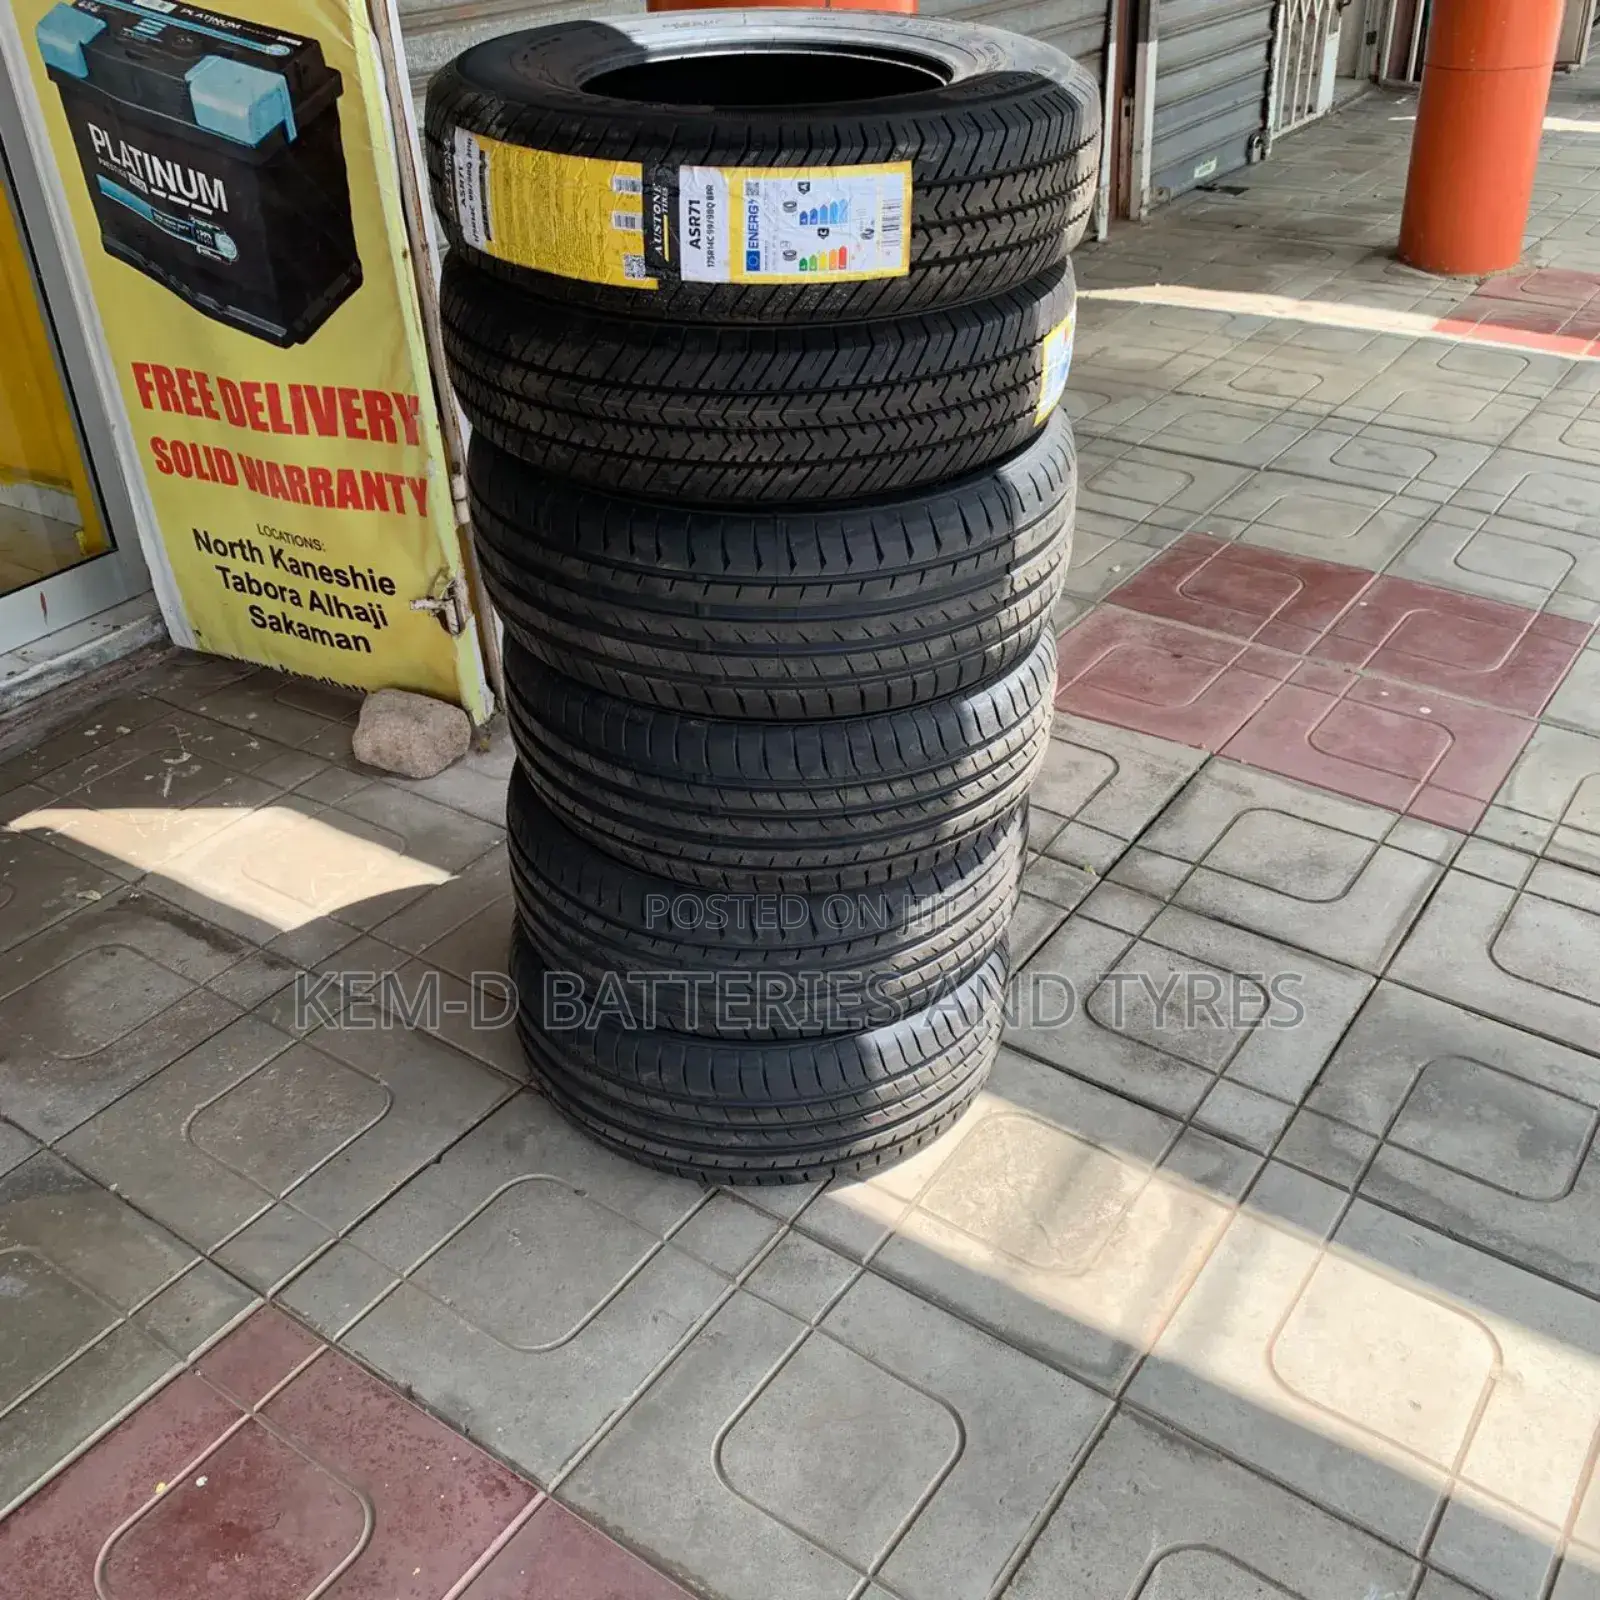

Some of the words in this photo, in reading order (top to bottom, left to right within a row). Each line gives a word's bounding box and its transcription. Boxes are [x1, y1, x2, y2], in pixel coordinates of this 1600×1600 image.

[87, 122, 229, 214] PLATINUM
[652, 182, 663, 256] AUSTONE
[688, 199, 701, 250] ASR71
[131, 361, 221, 421] FREE
[216, 376, 420, 446] DELIVERY
[149, 435, 239, 487] SOLID
[237, 452, 428, 518] WARRANTY
[192, 528, 265, 566] North
[269, 544, 397, 596] Kaneshie
[256, 523, 326, 553] LOCATIONS:
[214, 564, 304, 608] Tabora
[308, 589, 390, 630] Alhaji
[248, 604, 373, 654] Sakaman
